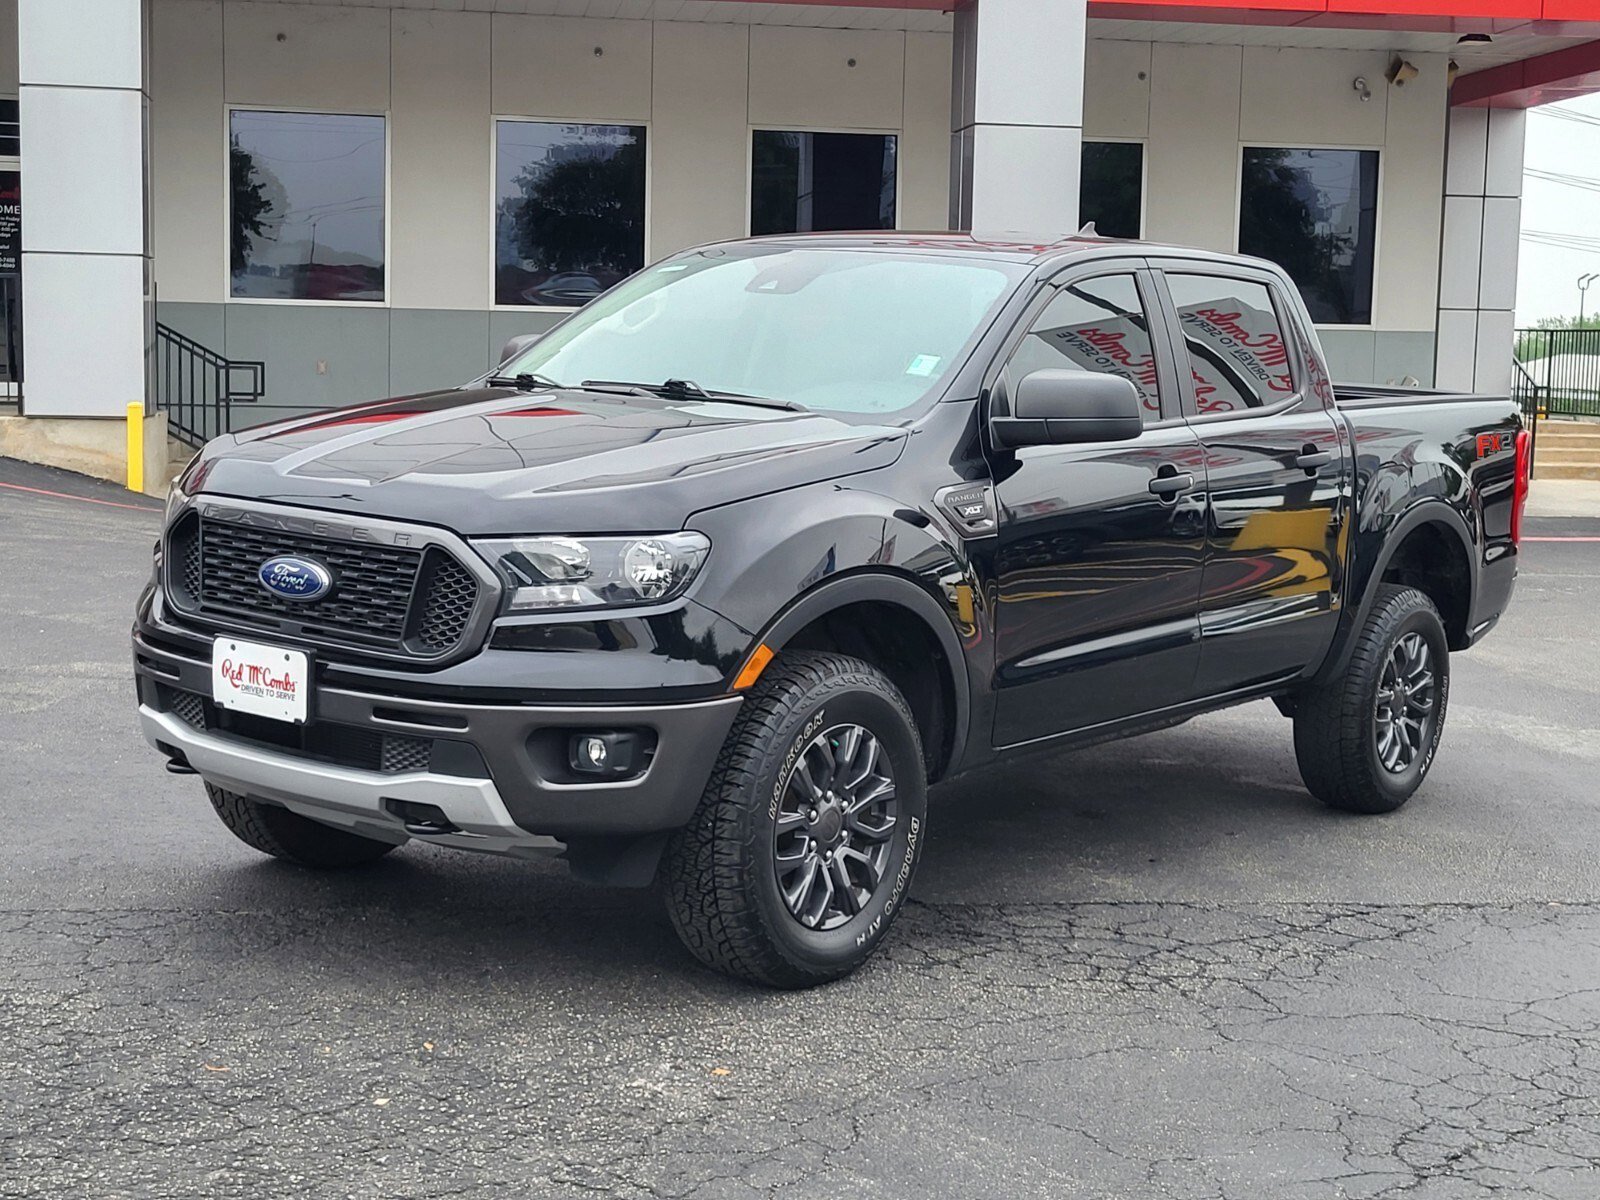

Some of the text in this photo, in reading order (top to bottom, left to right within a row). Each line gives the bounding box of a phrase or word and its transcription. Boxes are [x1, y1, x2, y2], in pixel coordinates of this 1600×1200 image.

[947, 492, 984, 503] RANGER
[964, 505, 983, 516] XLT
[270, 563, 309, 591] Ford
[221, 658, 244, 688] Red
[241, 684, 296, 702] DRIVEN TO SERVE
[768, 709, 825, 820] HANKOOK
